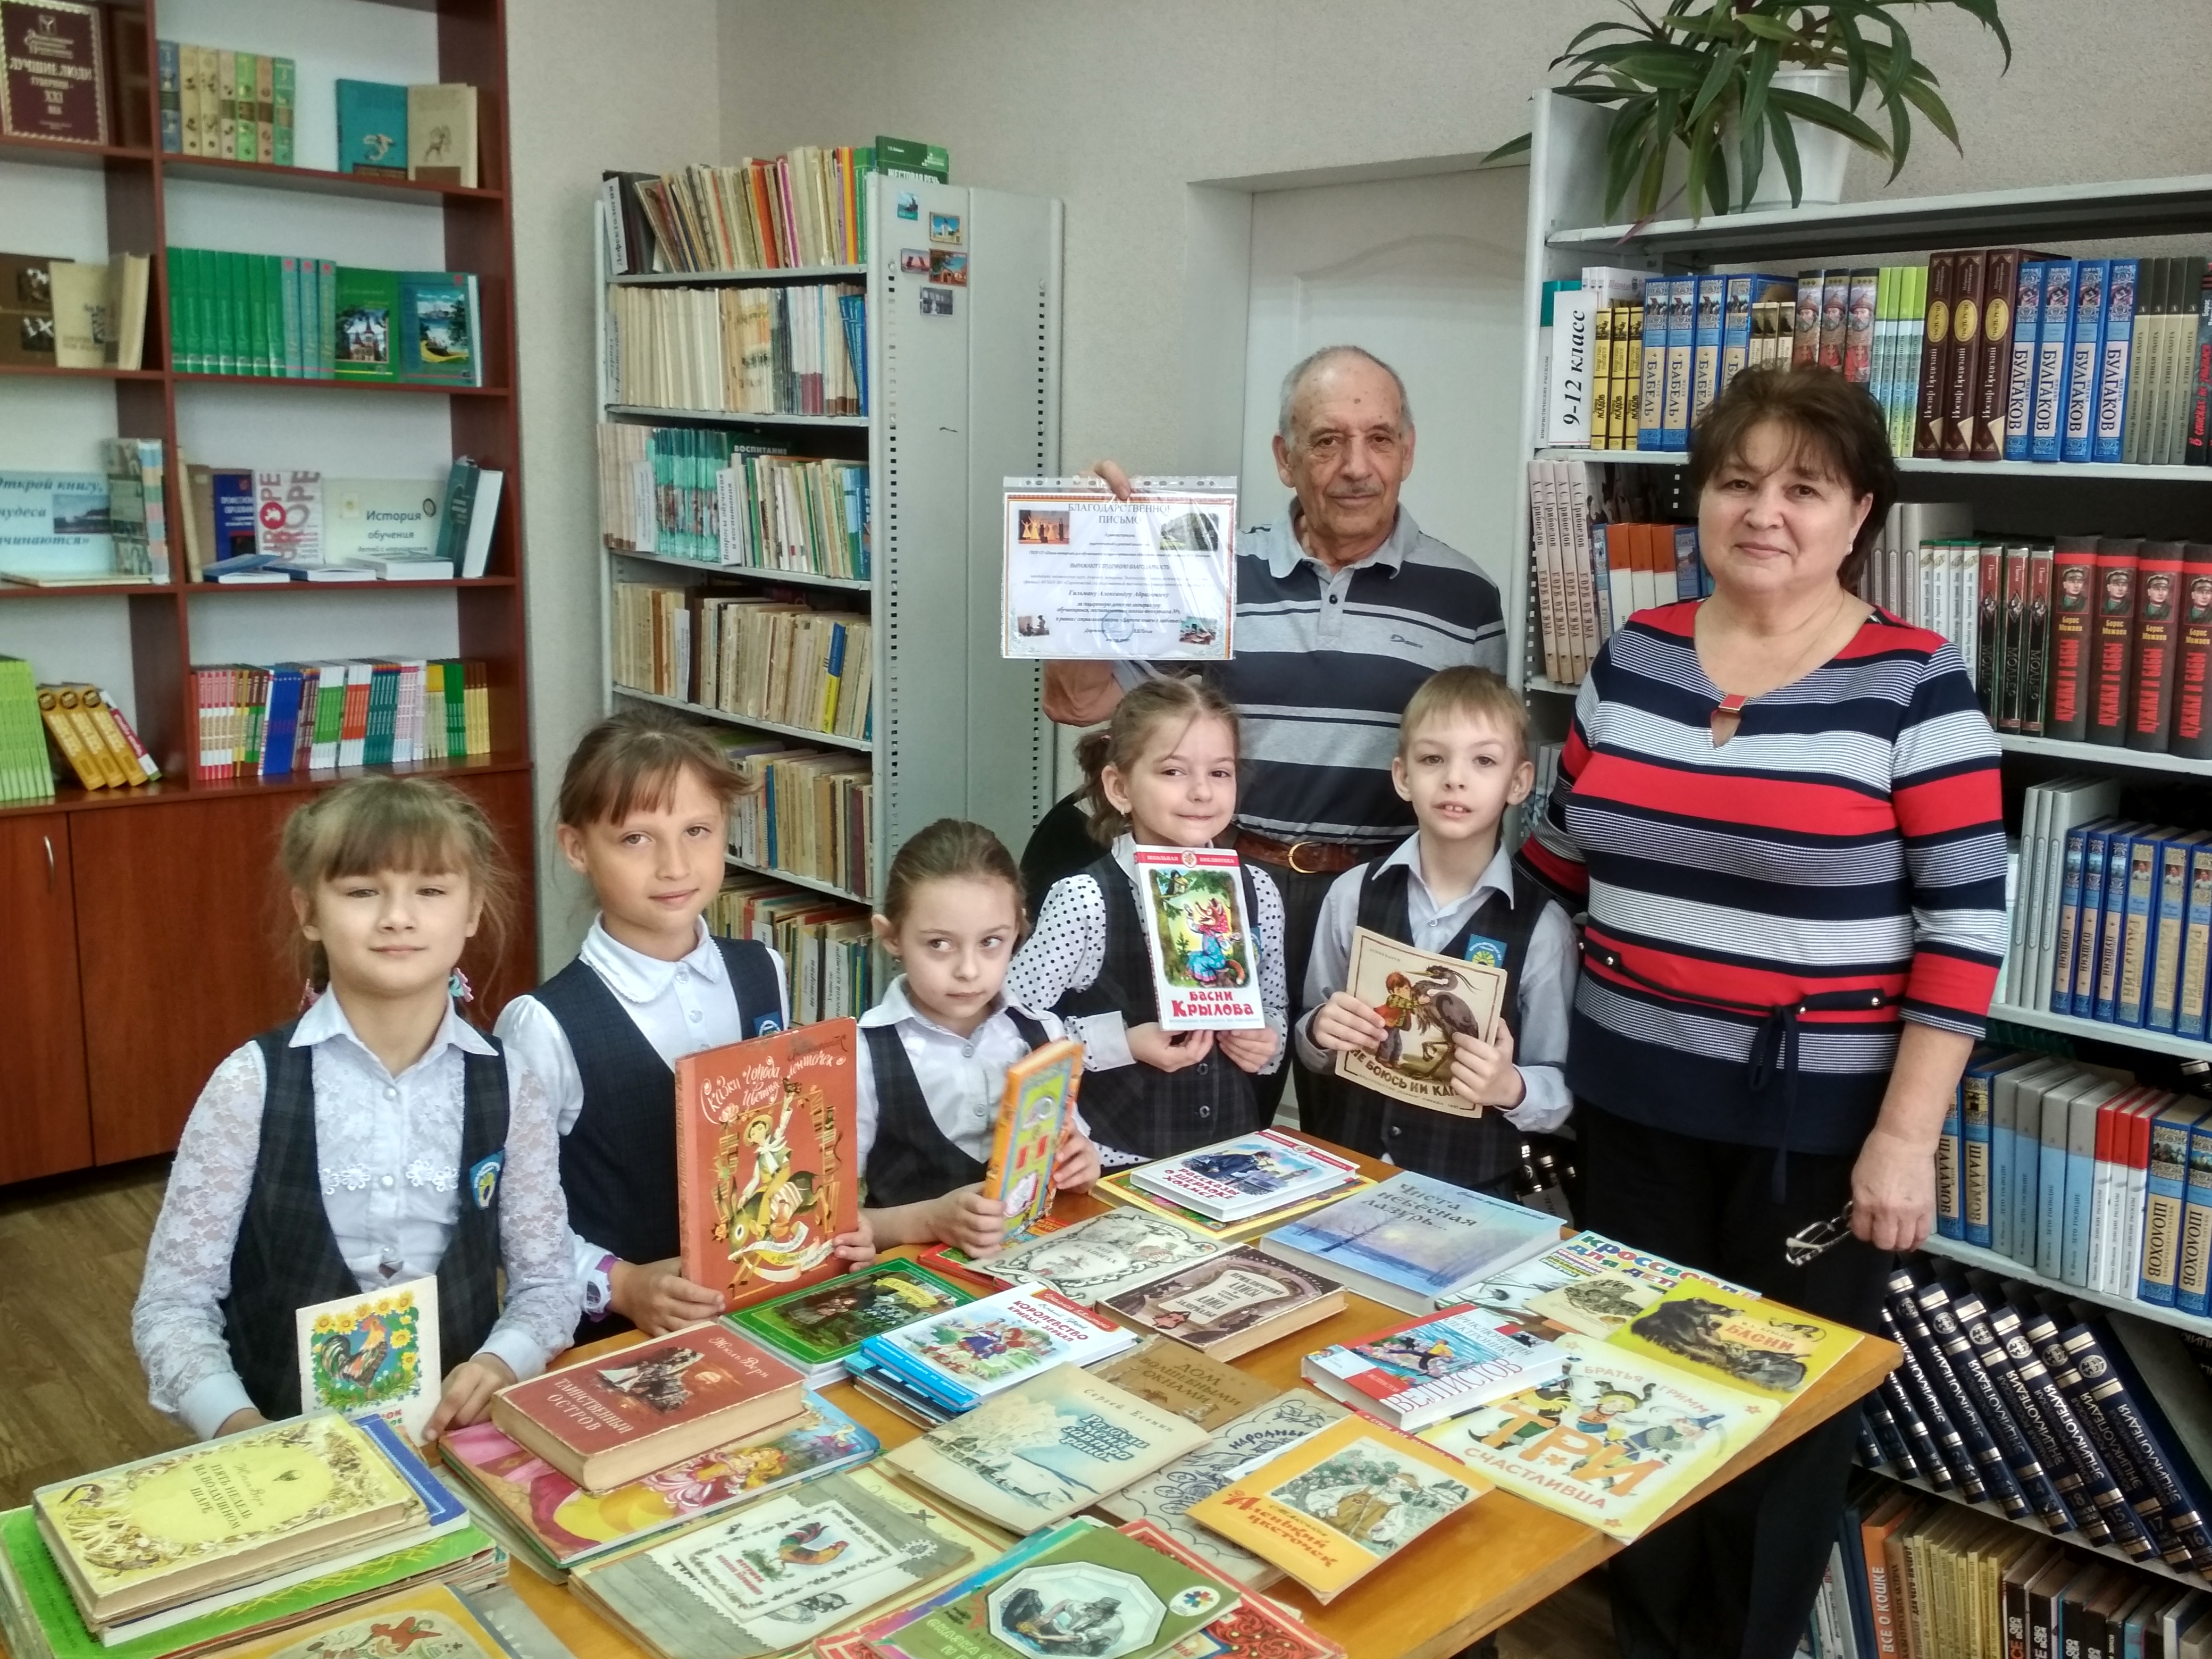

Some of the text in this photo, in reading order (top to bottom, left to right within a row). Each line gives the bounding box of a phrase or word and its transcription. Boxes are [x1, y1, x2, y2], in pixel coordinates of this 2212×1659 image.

[1562, 310, 1586, 426] 9-12 класс
[1644, 360, 1657, 416] БАБЕЛЬ
[1669, 360, 1683, 417] БАБЕЛЬ
[1924, 390, 1935, 418] Иосиф
[1952, 390, 1964, 418] Иосиф
[1982, 390, 1994, 418] Иосиф
[2008, 349, 2028, 430] БУЛГАКОВ
[2037, 349, 2057, 432] БУЛГАКОВ
[2069, 349, 2090, 432] БУЛГАКОВ
[2101, 348, 2122, 432] БУЛГАКОВ
[734, 445, 787, 455] ВОСПИТАНИЕ
[366, 510, 421, 523] История
[368, 530, 414, 541] обучения
[1099, 515, 1142, 524] ПИСЬМО
[1532, 501, 1543, 546] Грибоедов
[1544, 502, 1556, 547] Грибоедов
[1559, 502, 1571, 547] Грибоедов
[1572, 502, 1586, 548] Грибоедов
[2059, 623, 2083, 633] Можаев
[2062, 616, 2080, 625] Борис
[2102, 626, 2127, 635] Можаев
[2106, 619, 2124, 629] Борис
[2142, 631, 2167, 641] Можаев
[2145, 624, 2164, 633] Борис
[2185, 635, 2210, 645] Можаев
[2189, 627, 2208, 637] Борис
[2059, 929, 2069, 969] ПУШКИН
[2080, 932, 2091, 972] ПУШКИН
[2102, 935, 2113, 976] ПУШКИН
[2123, 918, 2140, 998] РАСПУТИН
[2183, 929, 2202, 1009] РАСПУТИН
[1171, 1000, 1255, 1018] КРЫЛОВА
[1189, 991, 1234, 1002] БАСНИ
[1366, 1060, 1407, 1090] БОЮСЬ
[1410, 1082, 1429, 1096] НИ
[1162, 1176, 1217, 1200] ХОЛМСЕ
[1174, 1173, 1236, 1200] ШЕРЛОКЕ
[1178, 1168, 1241, 1196] РАССКАЗЫ
[1939, 1138, 1951, 1213] ШАЛАМОВ
[1968, 1144, 1982, 1221] ШАЛАМОВ
[1377, 1192, 1478, 1227] небесная
[1400, 1183, 1462, 1211] Чиста
[1081, 1246, 1118, 1264] САПОГАХ
[1096, 1245, 1114, 1254] КОТ
[2148, 1202, 2168, 1277] ШОЛОХОВ
[2183, 1210, 2203, 1287] ШОЛОХОВ
[1194, 1295, 1229, 1310] АЛИСА
[1227, 1281, 1264, 1298] АЛИСЫ
[1007, 1306, 1075, 1343] КРИВЫХ ЗЕРКАЛ
[1012, 1300, 1090, 1341] КОРОЛЕВСТВО
[1453, 1314, 1535, 1356] ПРИКЛЮЧЕНИЯ
[1724, 1323, 1796, 1352] БАСНИ
[708, 1336, 770, 1379] Жюль Верн
[1174, 1363, 1221, 1387] ДОМ
[1140, 1357, 1242, 1406] ВОЛШЕБНЫМИ
[1143, 1370, 1211, 1404] ОКНАМИ
[1379, 1358, 1523, 1413] ВЕЛТИСТОВ
[1583, 1365, 1711, 1414] БРАТЬЯ ГРИММ
[547, 1394, 602, 1432] ОСТРОВ
[554, 1378, 635, 1434] ТАИНСТВЕННЫЙ
[1084, 1388, 1175, 1433] Сергей Есенин
[1968, 1359, 2025, 1452] ЭНЦИКЛОПЕДИЯ
[2006, 1370, 2065, 1465] ЭНЦИКЛОПЕДИЯ
[1061, 1426, 1136, 1461] завтра
[1080, 1413, 1151, 1449] Разбуди
[1082, 1425, 1131, 1450] меня
[1481, 1401, 1666, 1497] ТРИ
[2043, 1384, 2105, 1480] ЭНЦИКЛОПЕДИЯ
[2080, 1392, 2143, 1489] ЭНЦИКЛОПЕДИЯ
[2117, 1403, 2182, 1503] ЭНЦИКЛОПЕДИЯ
[192, 1464, 241, 1529] НА ВОЗДУШНОМ
[211, 1464, 253, 1519] ПЯТЬ НЕДЕЛЬ
[1463, 1446, 1608, 1510] СЧАСТЛИВЦА
[190, 1487, 214, 1514] ШАРЕ
[1221, 1495, 1331, 1550] Аленький
[1872, 1566, 1895, 1653] ВСЕ О КОШКЕ
[926, 1618, 981, 1655] СКАЗКА
